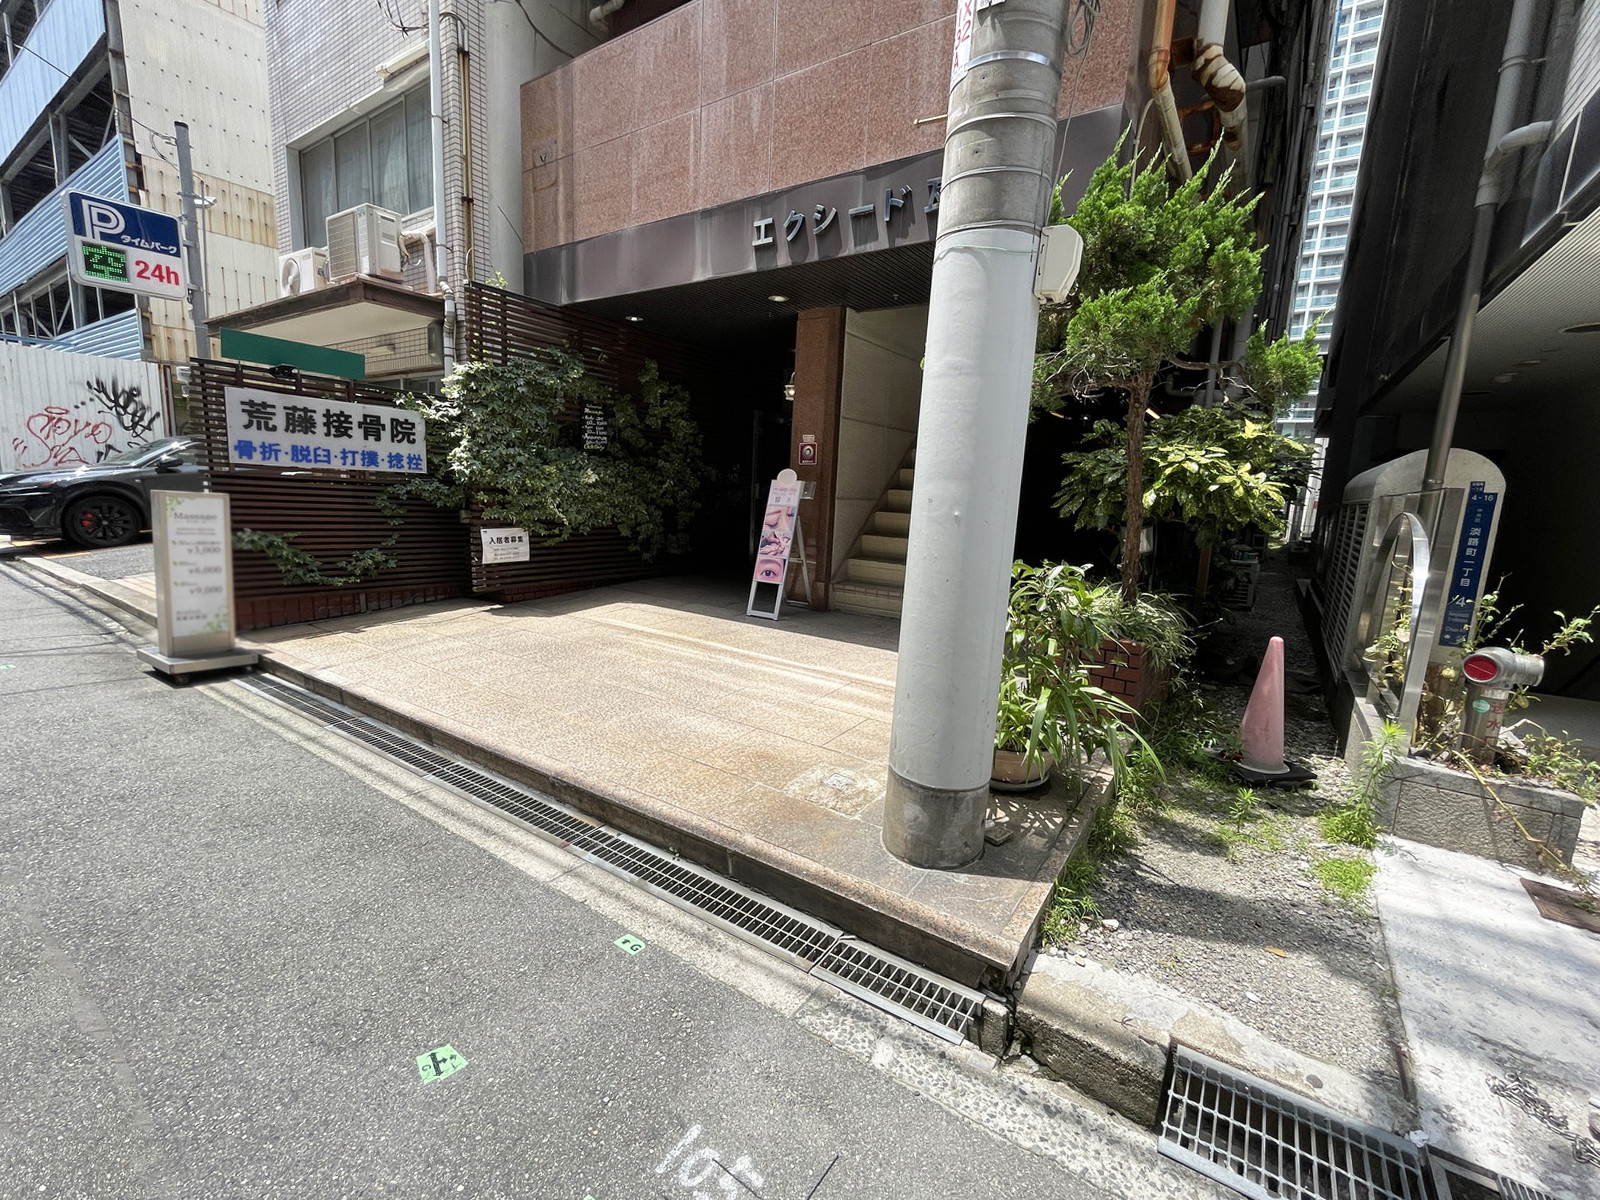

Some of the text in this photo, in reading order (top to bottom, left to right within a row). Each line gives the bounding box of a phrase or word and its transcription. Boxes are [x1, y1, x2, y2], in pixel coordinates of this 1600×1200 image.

[81, 199, 125, 241] P
[82, 245, 129, 283] 空
[120, 235, 177, 253] タイムパーク
[135, 260, 180, 286] 24h
[240, 399, 417, 445] 荒藤接骨院
[1459, 527, 1482, 587] 淡路町一丁目
